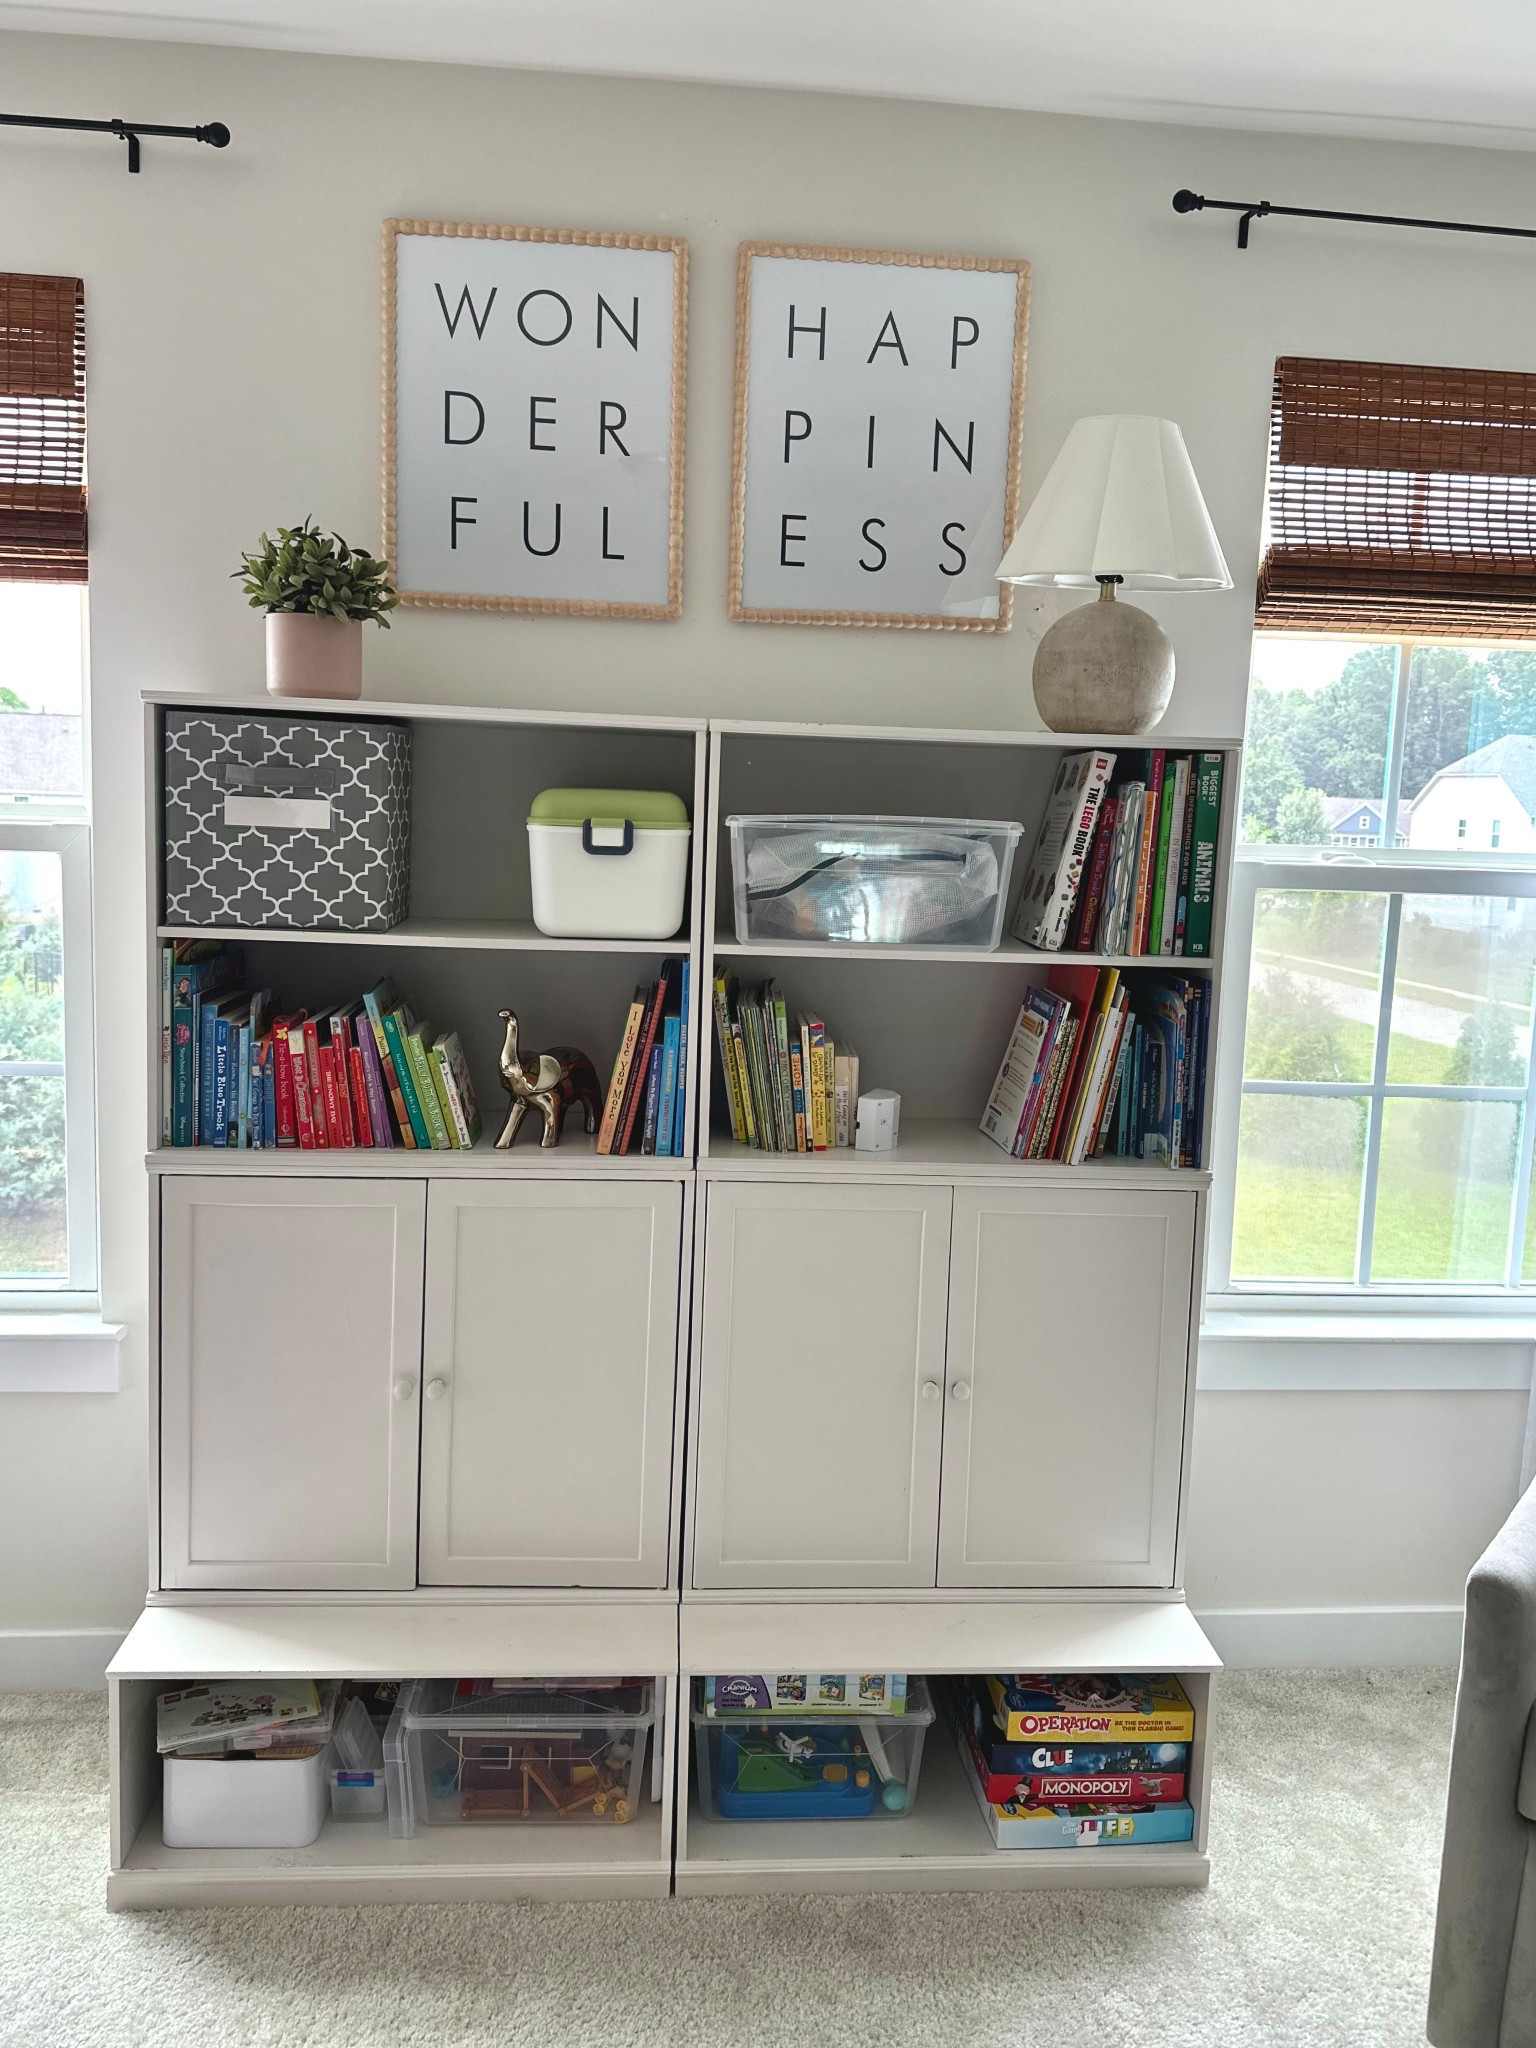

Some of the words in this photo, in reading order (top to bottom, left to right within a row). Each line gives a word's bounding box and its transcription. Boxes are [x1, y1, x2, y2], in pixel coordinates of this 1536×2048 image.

[433, 283, 639, 352] WON
[787, 304, 980, 370] HAP
[443, 390, 631, 457] DER
[784, 410, 975, 475] PIN
[450, 496, 625, 561] FUL
[780, 514, 968, 577] ESS
[1086, 786, 1100, 806] THE
[1201, 776, 1210, 796] BOOK
[1208, 770, 1218, 807] BIGGEST
[1079, 805, 1095, 830] LEGO
[1184, 796, 1195, 850] INFOGRAPHICS
[1071, 829, 1088, 858] BOOK
[1171, 848, 1179, 859] MY
[1173, 838, 1179, 846] IN
[1096, 860, 1105, 873] Blue
[1138, 841, 1149, 894] ELLIE
[1169, 861, 1177, 886] HEART
[1193, 841, 1213, 904] ANIMALS
[1083, 897, 1098, 934] Christmas
[377, 1035, 389, 1056] Psalms
[623, 1026, 635, 1057] Love
[204, 1047, 212, 1086] counting
[216, 1046, 226, 1074] Little
[278, 1043, 288, 1079] Tie-a-bow
[414, 1056, 429, 1079] BELLY
[780, 1060, 788, 1078] NANCY
[792, 1056, 801, 1086] ROME
[616, 1060, 629, 1086] You
[217, 1077, 226, 1098] Blue
[280, 1080, 289, 1099] book
[327, 1084, 335, 1109] SNOWY
[421, 1079, 437, 1108] BUTTON
[1109, 1087, 1117, 1104] JOKES
[216, 1099, 225, 1131] Truck
[607, 1088, 622, 1121] More
[430, 1108, 444, 1131] BOOK!
[721, 1681, 758, 1694] CRANIUM
[1019, 1715, 1112, 1737] OPERATION
[1031, 1747, 1074, 1769] CLUE
[1044, 1781, 1129, 1795] MONOPOLY
[1062, 1825, 1082, 1835] Game
[1083, 1819, 1130, 1837] LIFE
